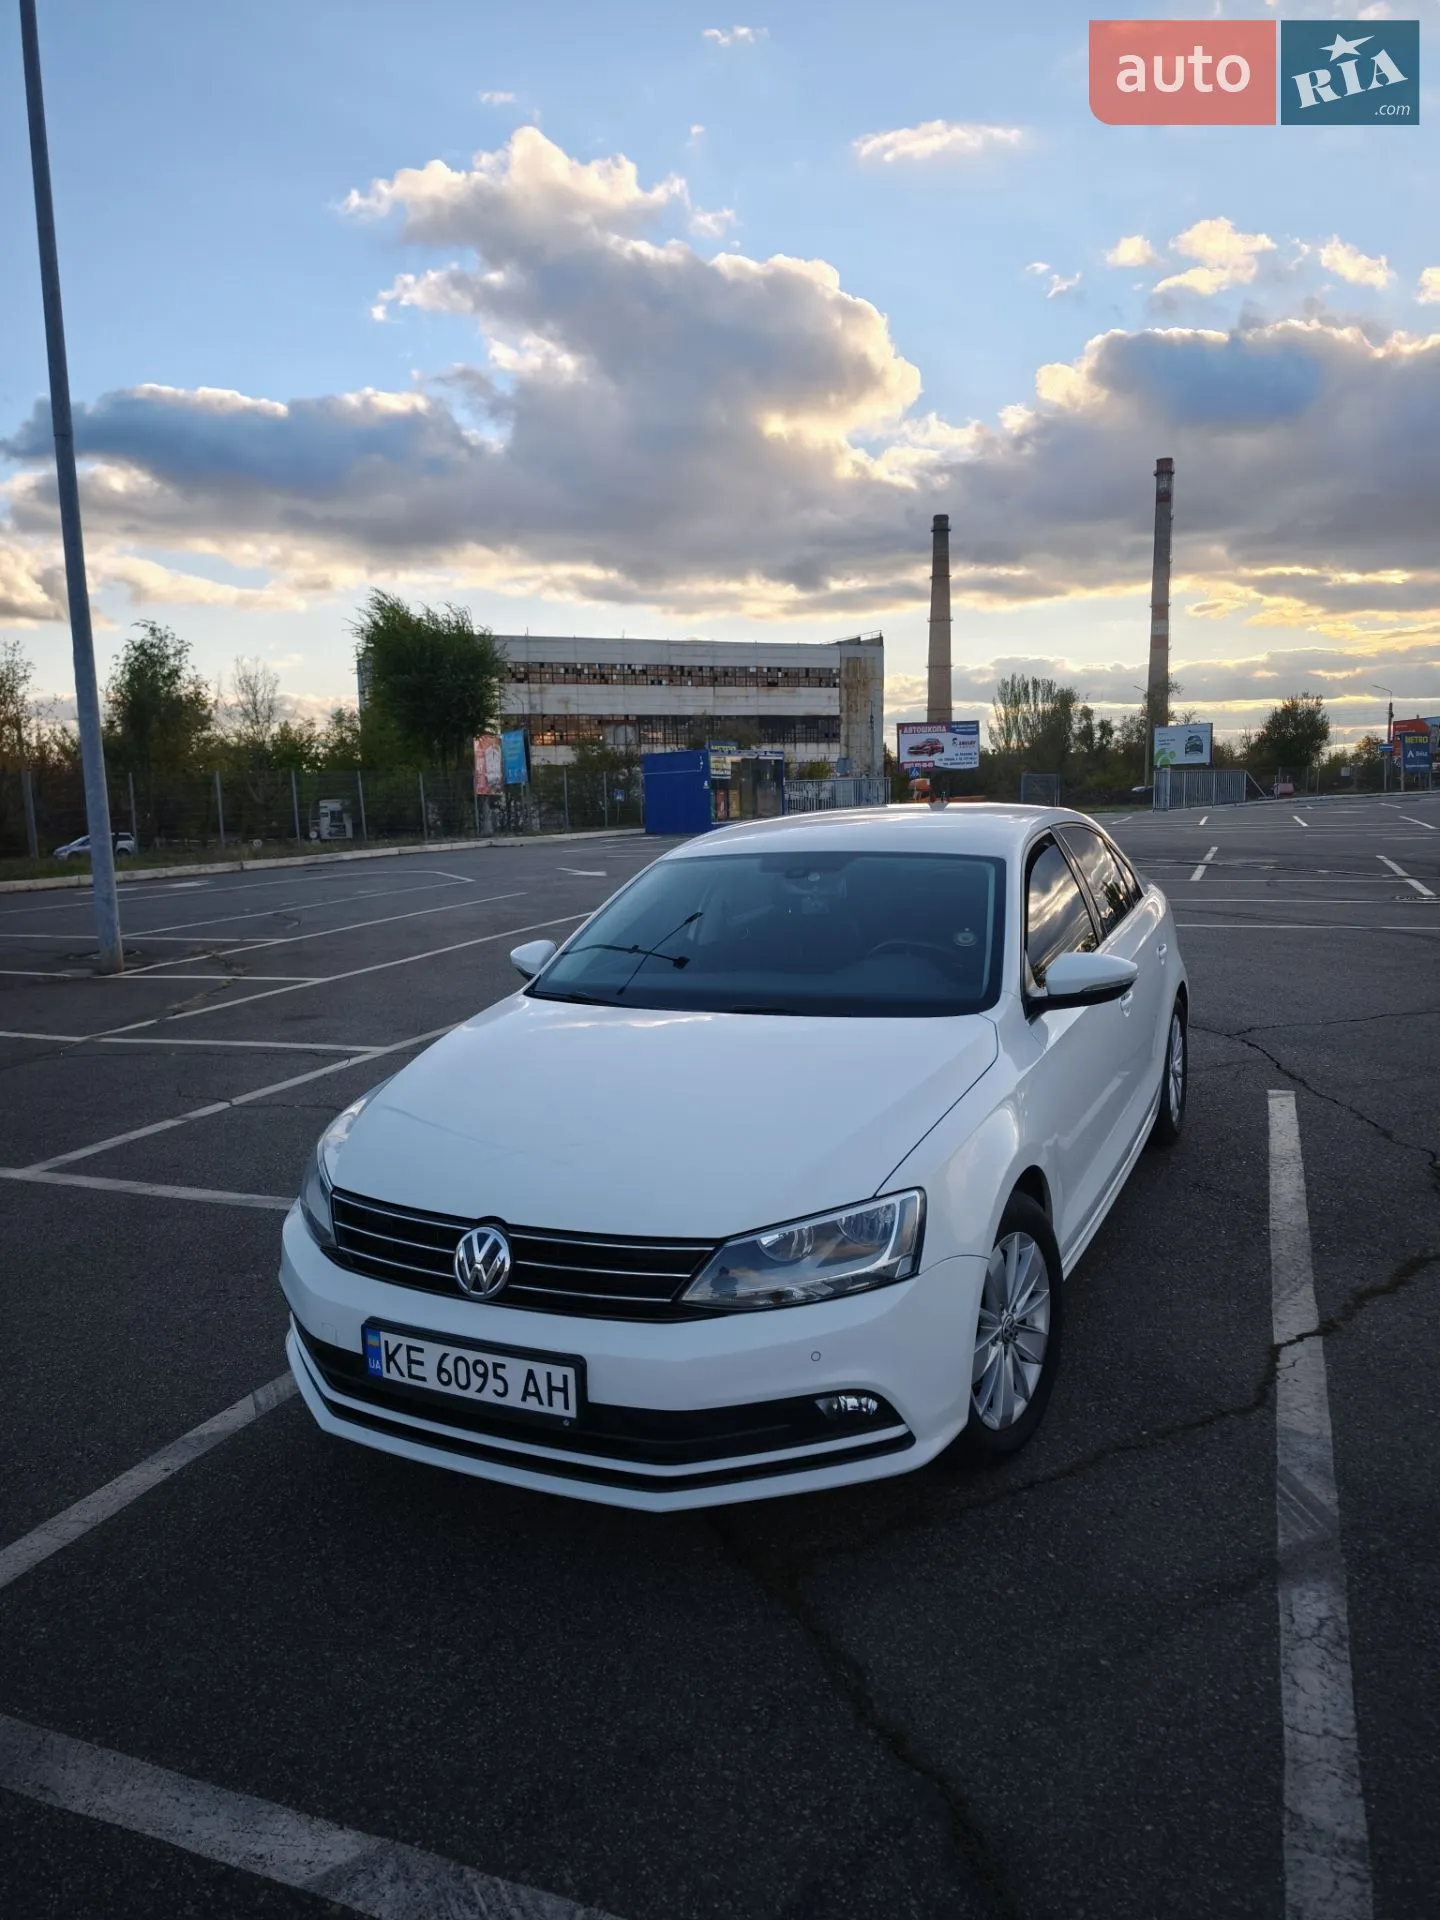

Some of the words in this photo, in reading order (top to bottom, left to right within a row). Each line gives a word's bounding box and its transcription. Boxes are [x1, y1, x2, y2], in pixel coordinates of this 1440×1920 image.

[903, 725, 947, 734] АВТОШКОЛА
[1405, 735, 1429, 744] METRO
[368, 1357, 382, 1371] UA
[384, 1340, 427, 1382] KE
[436, 1352, 509, 1398] 6095
[521, 1368, 570, 1411] AH
